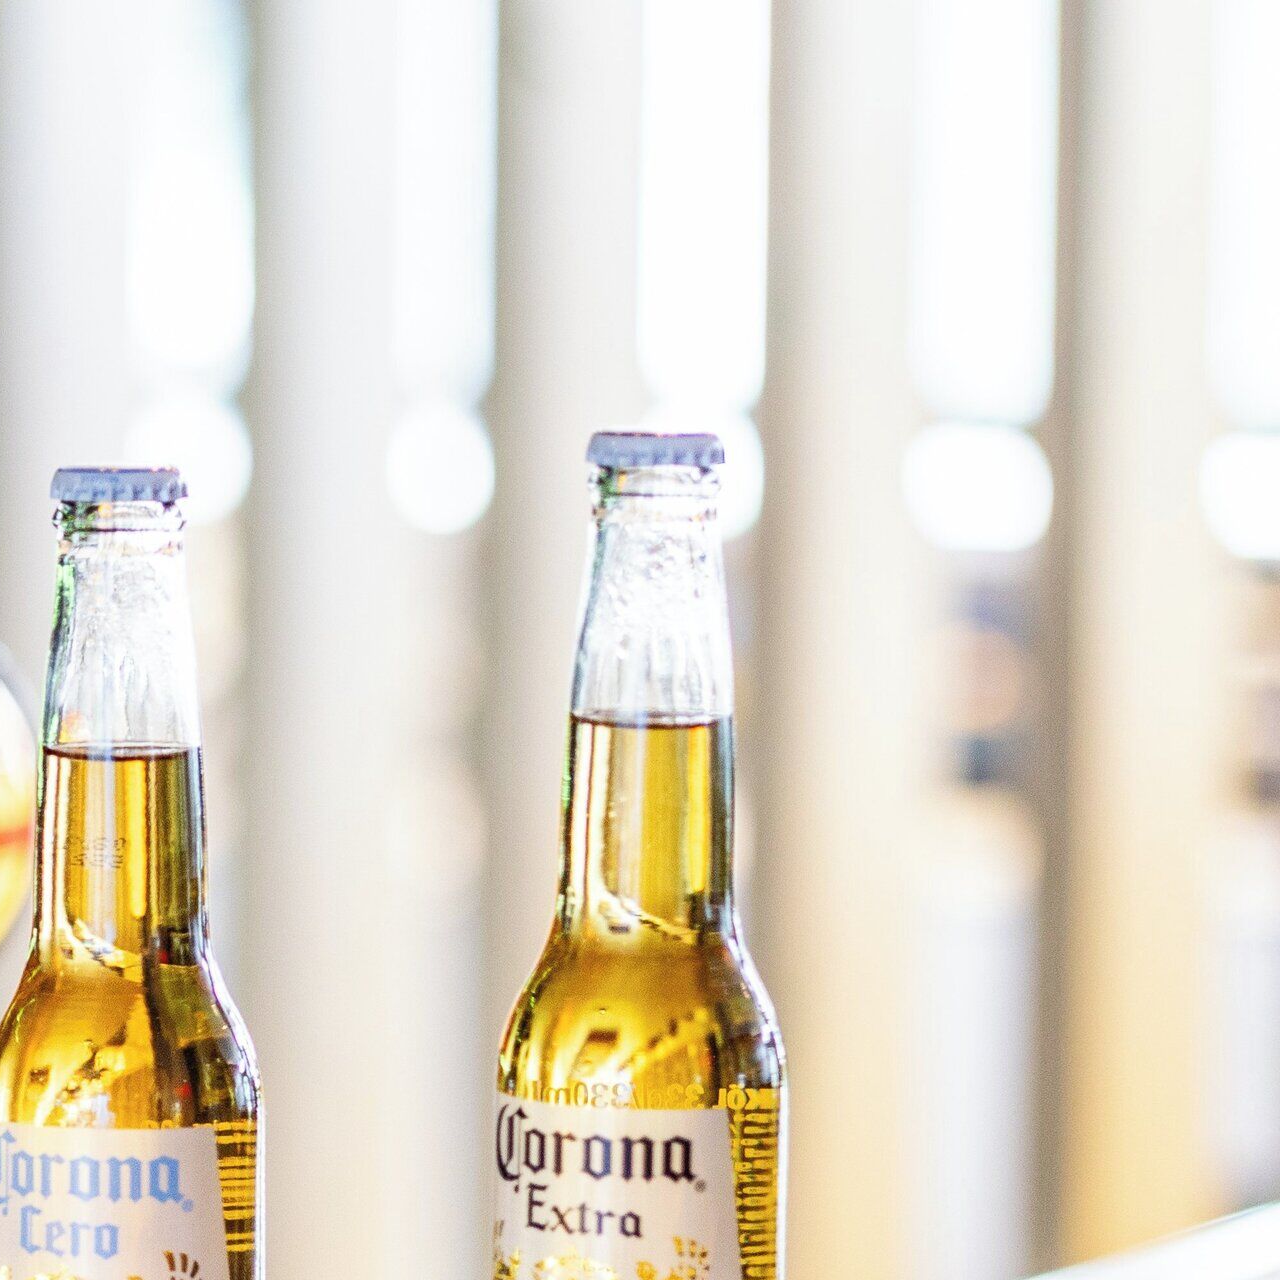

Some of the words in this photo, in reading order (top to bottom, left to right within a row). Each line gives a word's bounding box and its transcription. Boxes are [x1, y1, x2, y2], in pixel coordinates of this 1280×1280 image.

[496, 1103, 696, 1193] Corona
[20, 1205, 119, 1260] Cero
[526, 1183, 643, 1238] Extra
